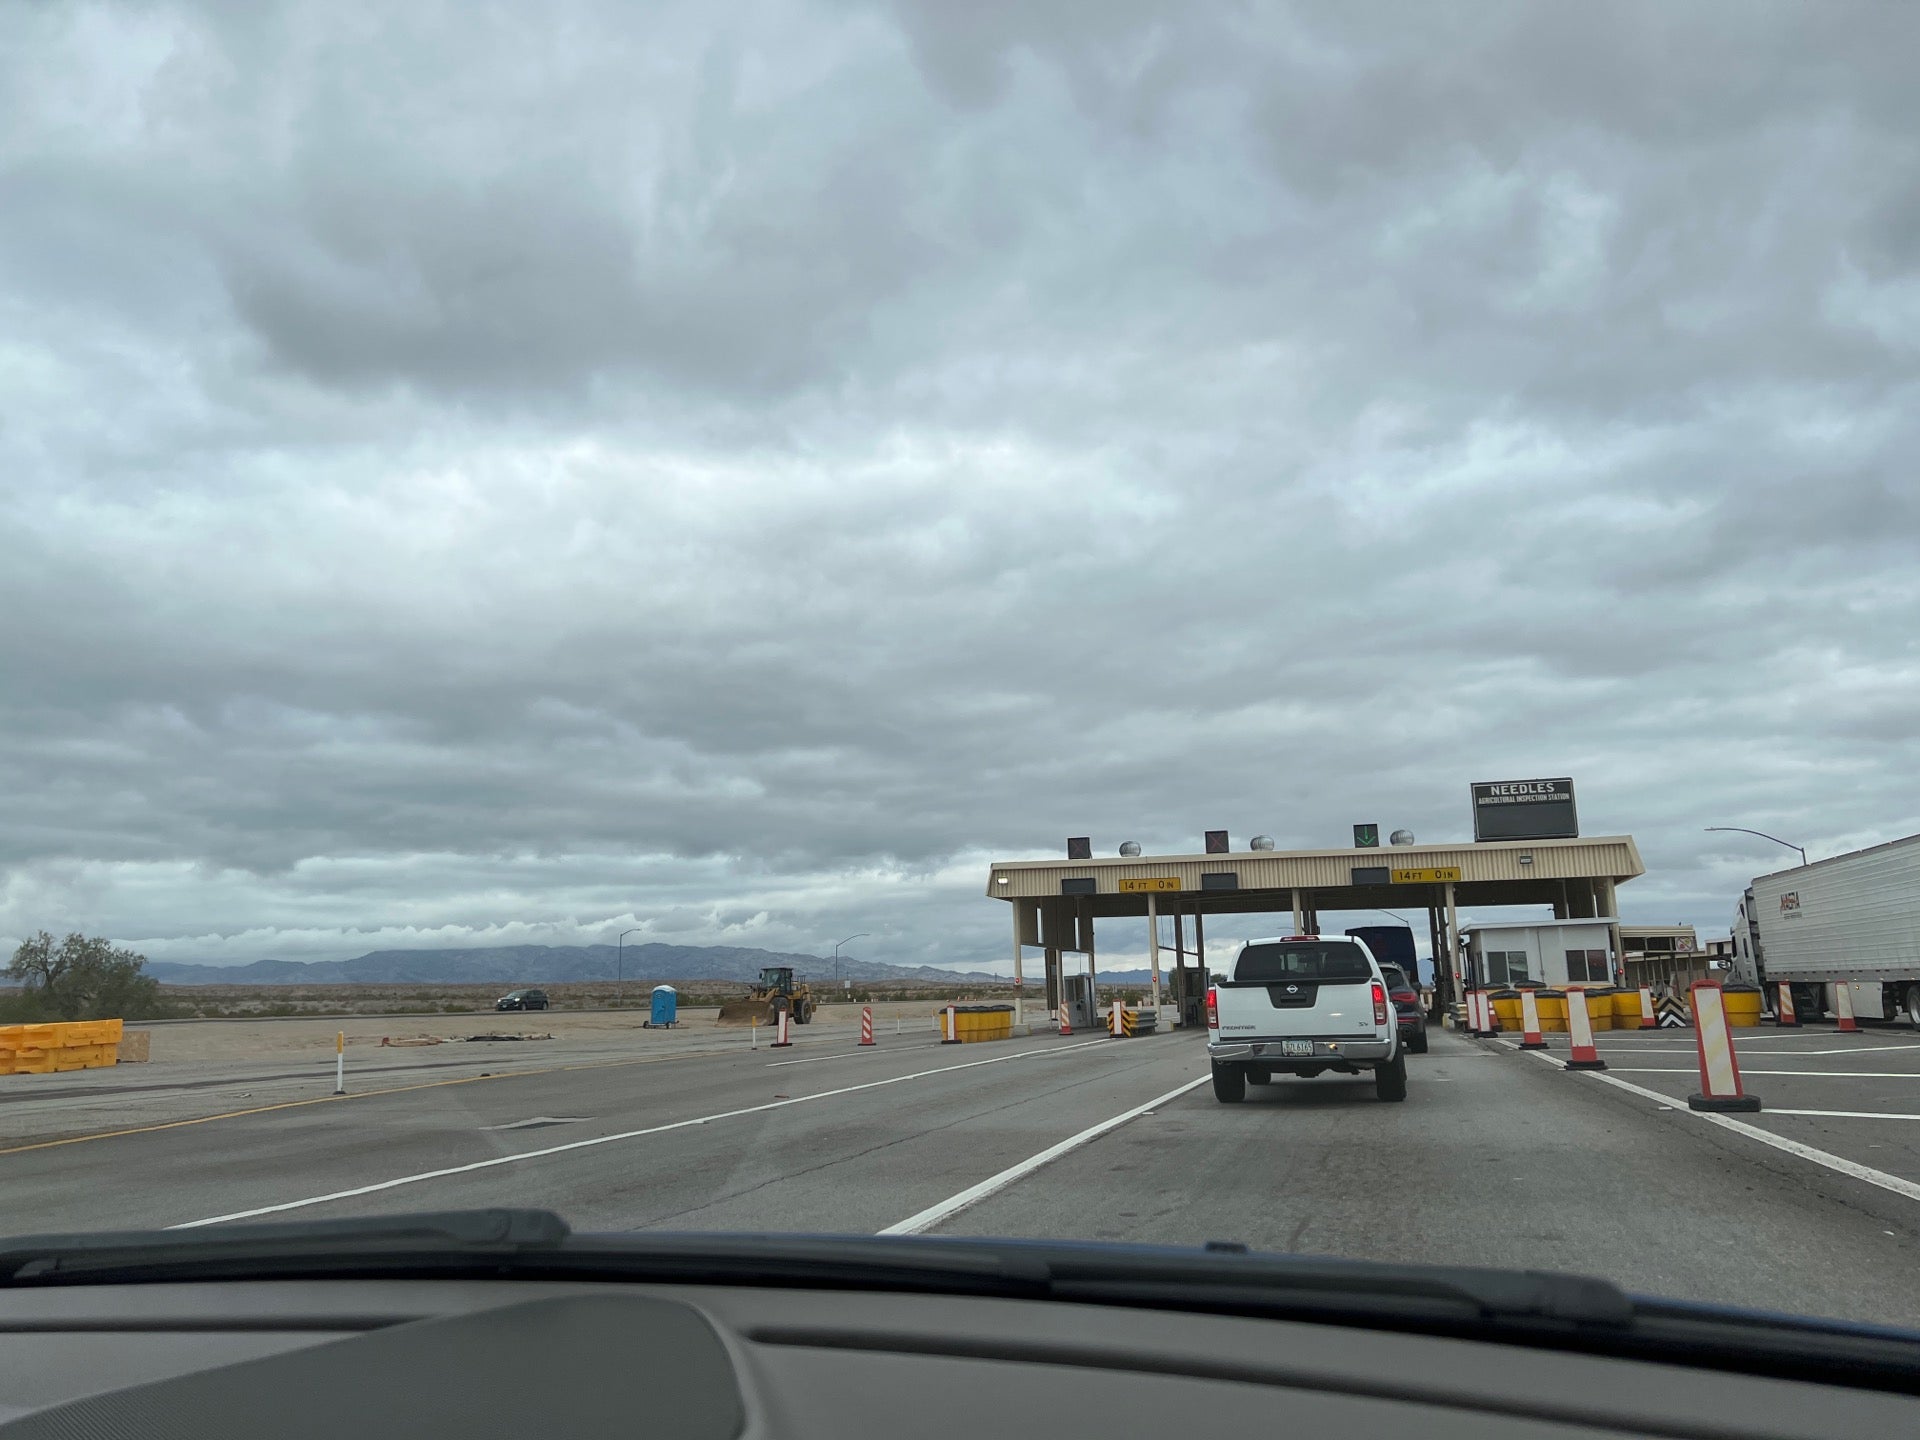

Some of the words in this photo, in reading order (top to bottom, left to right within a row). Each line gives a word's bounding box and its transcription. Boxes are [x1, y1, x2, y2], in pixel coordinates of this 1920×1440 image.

[1491, 783, 1555, 795] NEEDLES
[1478, 795, 1516, 804] AGRICULTURAL
[1516, 793, 1547, 803] INSPECTION
[1548, 792, 1570, 801] STATION
[1399, 871, 1411, 881] 14
[1412, 872, 1423, 880] FT
[1443, 871, 1453, 879] IN
[1125, 881, 1134, 890] 14
[1138, 882, 1147, 890] FT
